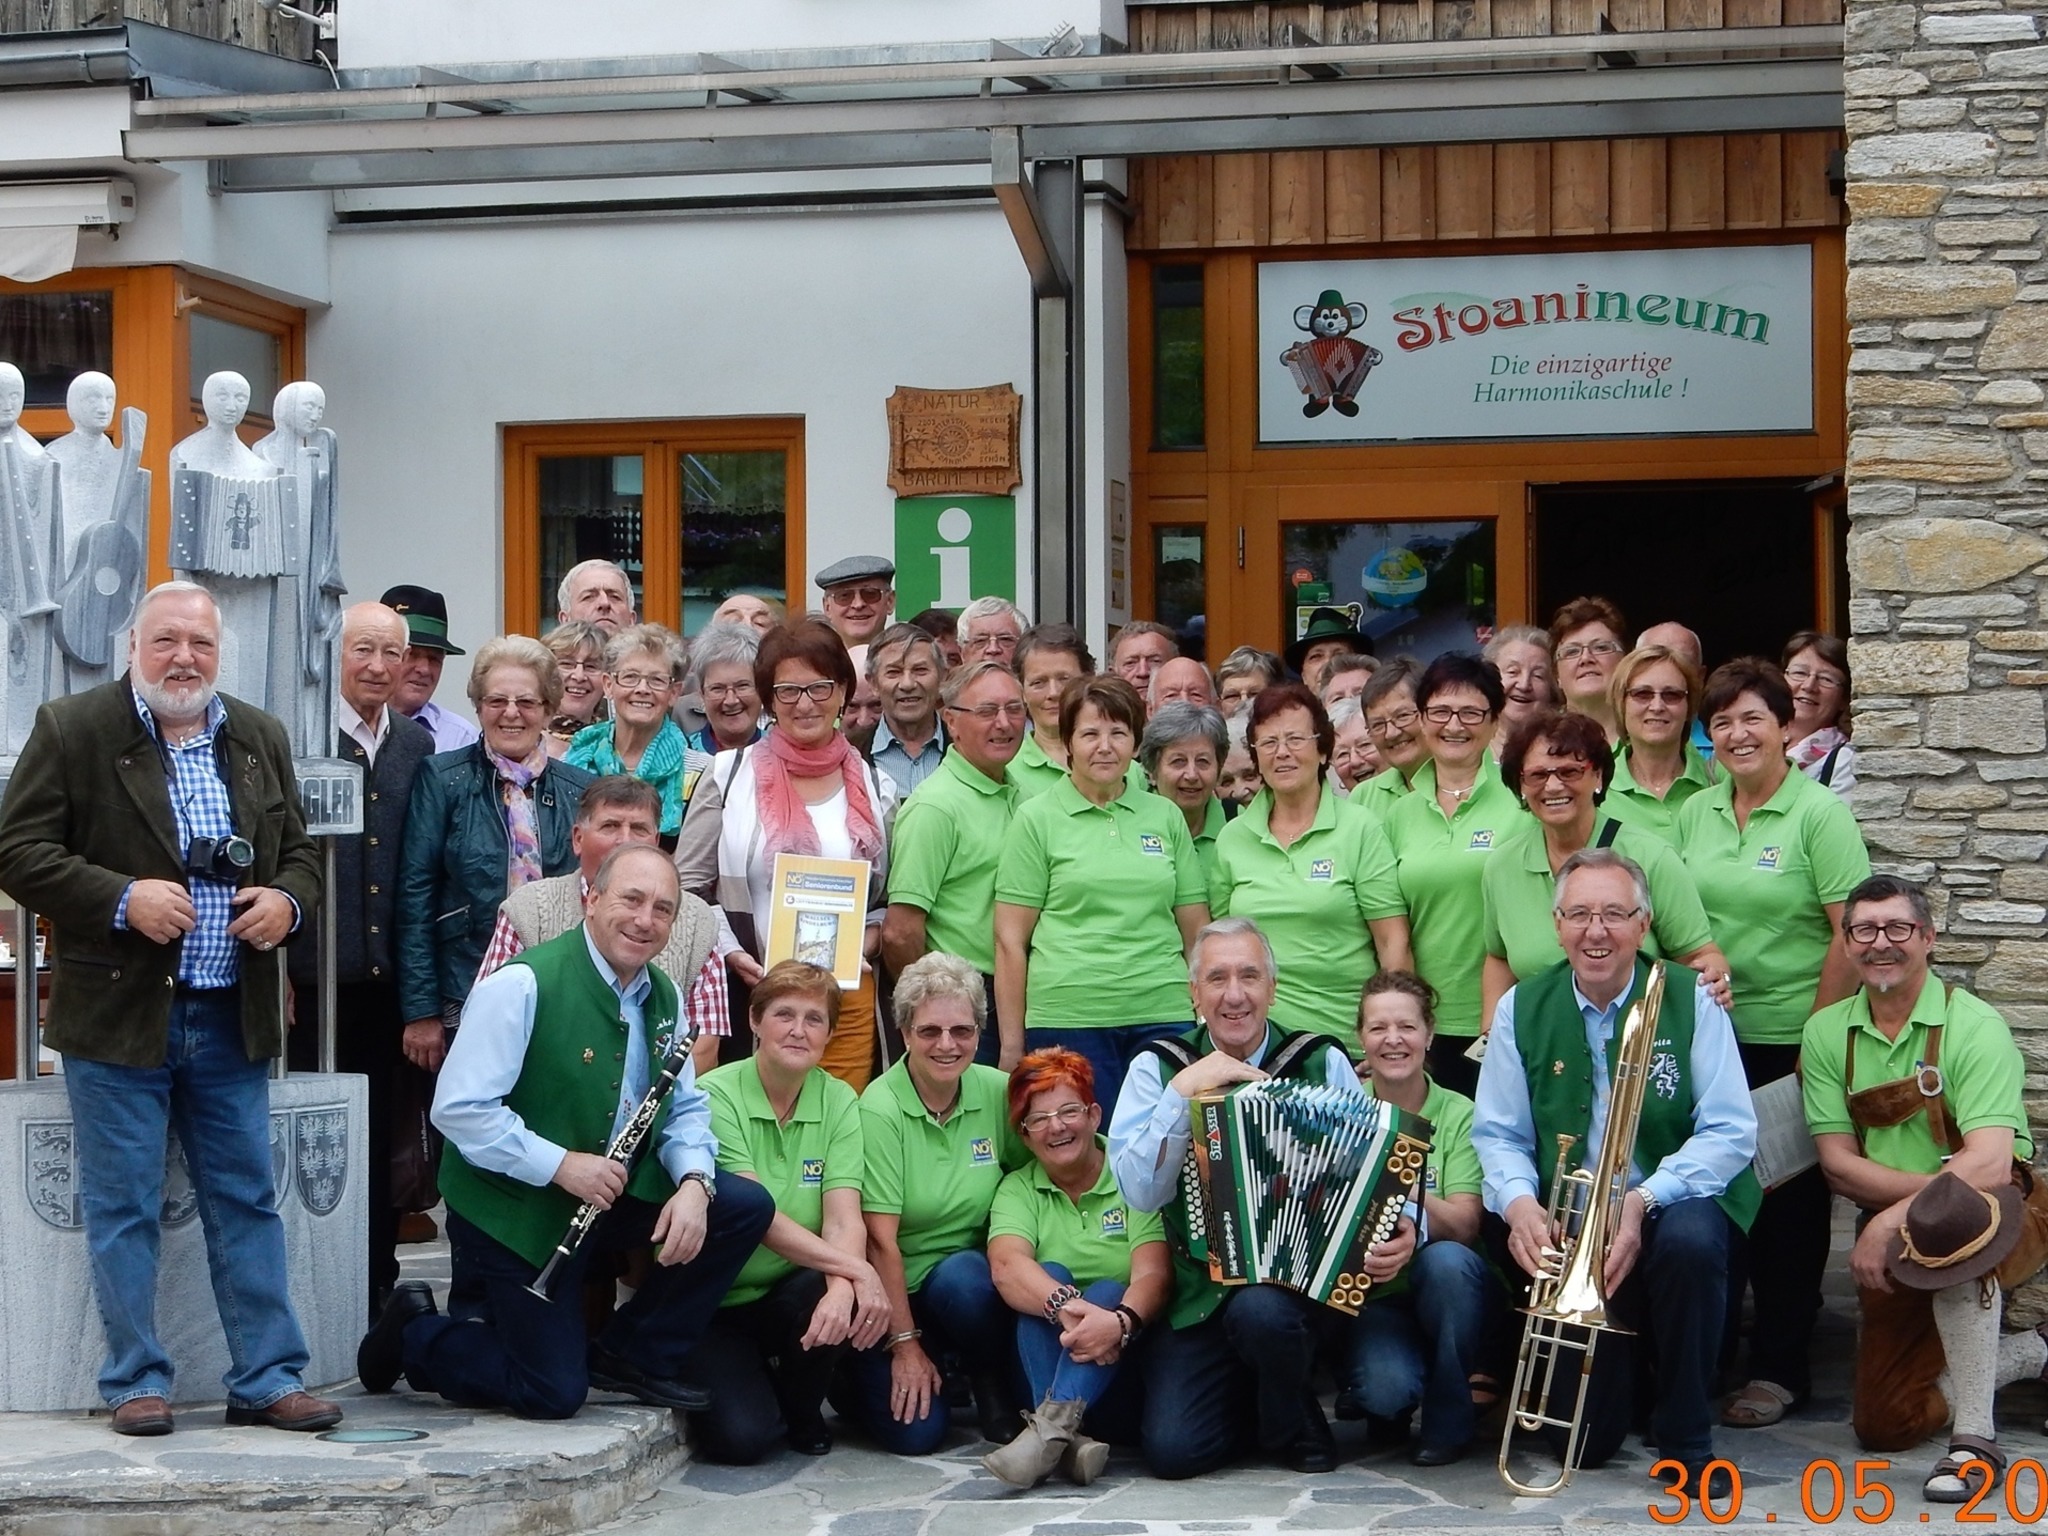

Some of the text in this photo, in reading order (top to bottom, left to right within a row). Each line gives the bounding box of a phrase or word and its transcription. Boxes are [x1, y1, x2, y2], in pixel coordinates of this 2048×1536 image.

[1392, 283, 1771, 352] Stoanineum
[1490, 351, 1672, 380] Die einzigartige
[923, 395, 980, 409] NATUR
[1473, 377, 1672, 404] Harmonikaschule
[929, 507, 976, 609] i
[296, 777, 355, 825] GLER
[804, 881, 853, 891] Seniorenbund
